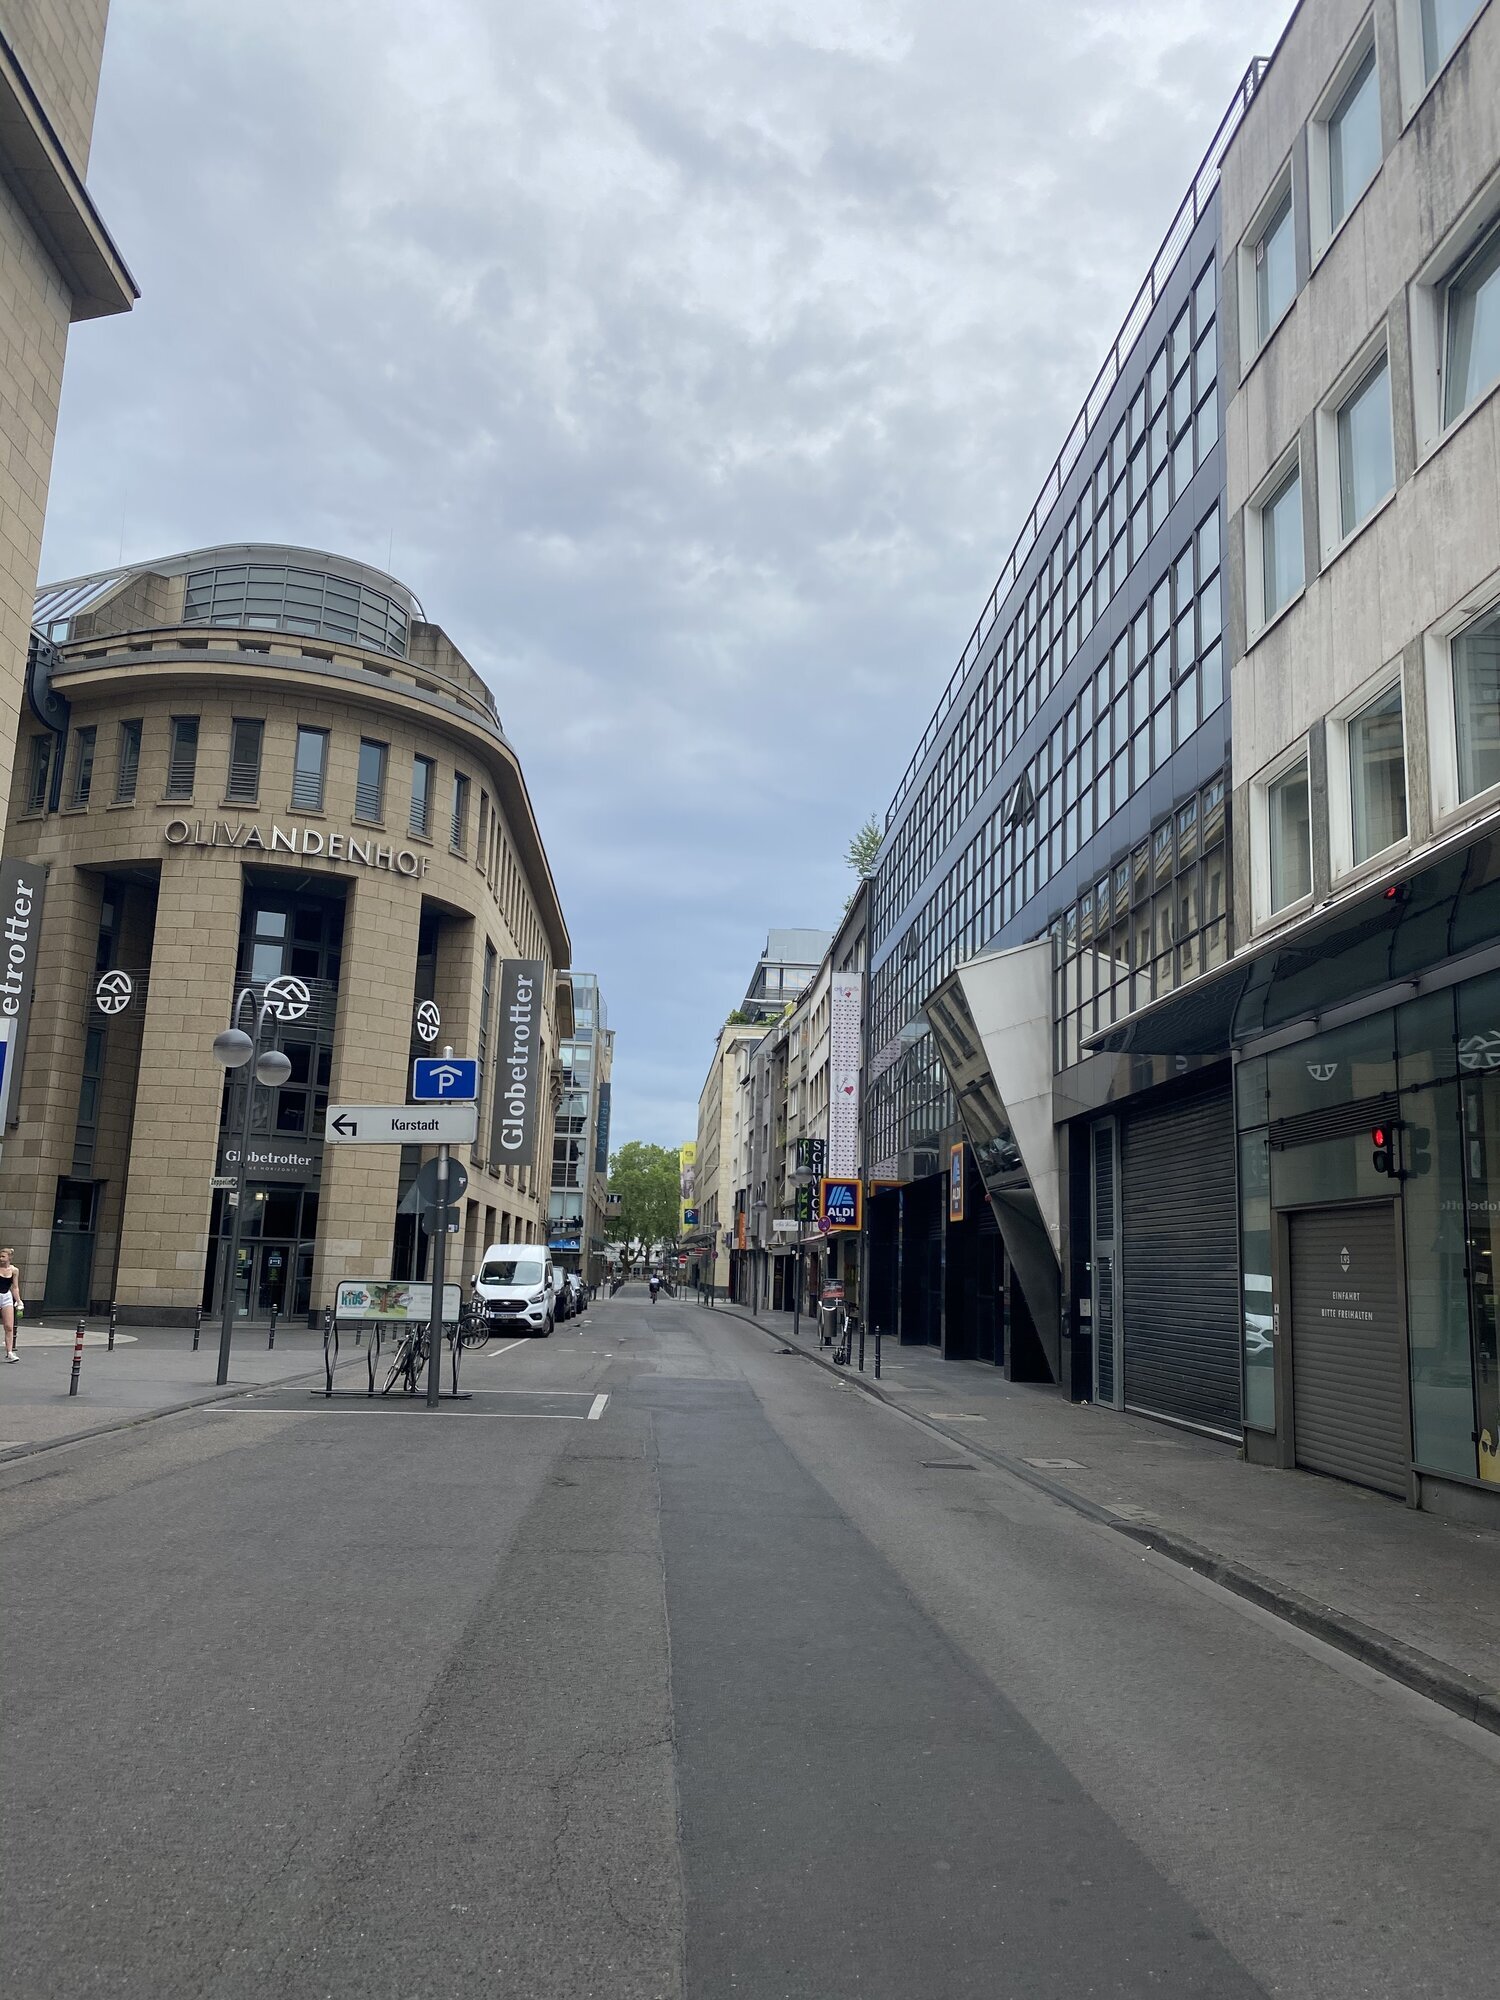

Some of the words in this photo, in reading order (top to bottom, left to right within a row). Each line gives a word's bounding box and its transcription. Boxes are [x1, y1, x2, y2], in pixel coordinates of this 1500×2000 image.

[164, 819, 431, 878] OLIVANDENHOF
[501, 973, 533, 1150] Globetrotter
[438, 1073, 455, 1095] P
[391, 1118, 440, 1131] Karstadt
[599, 1099, 609, 1153] PRIMARK
[811, 1140, 822, 1220] SCHMUCK
[827, 1207, 855, 1217] ALDI
[1332, 1291, 1360, 1301] EINFAHRT
[1321, 1308, 1336, 1318] BITTE
[1338, 1309, 1373, 1321] FREIHALTEN
